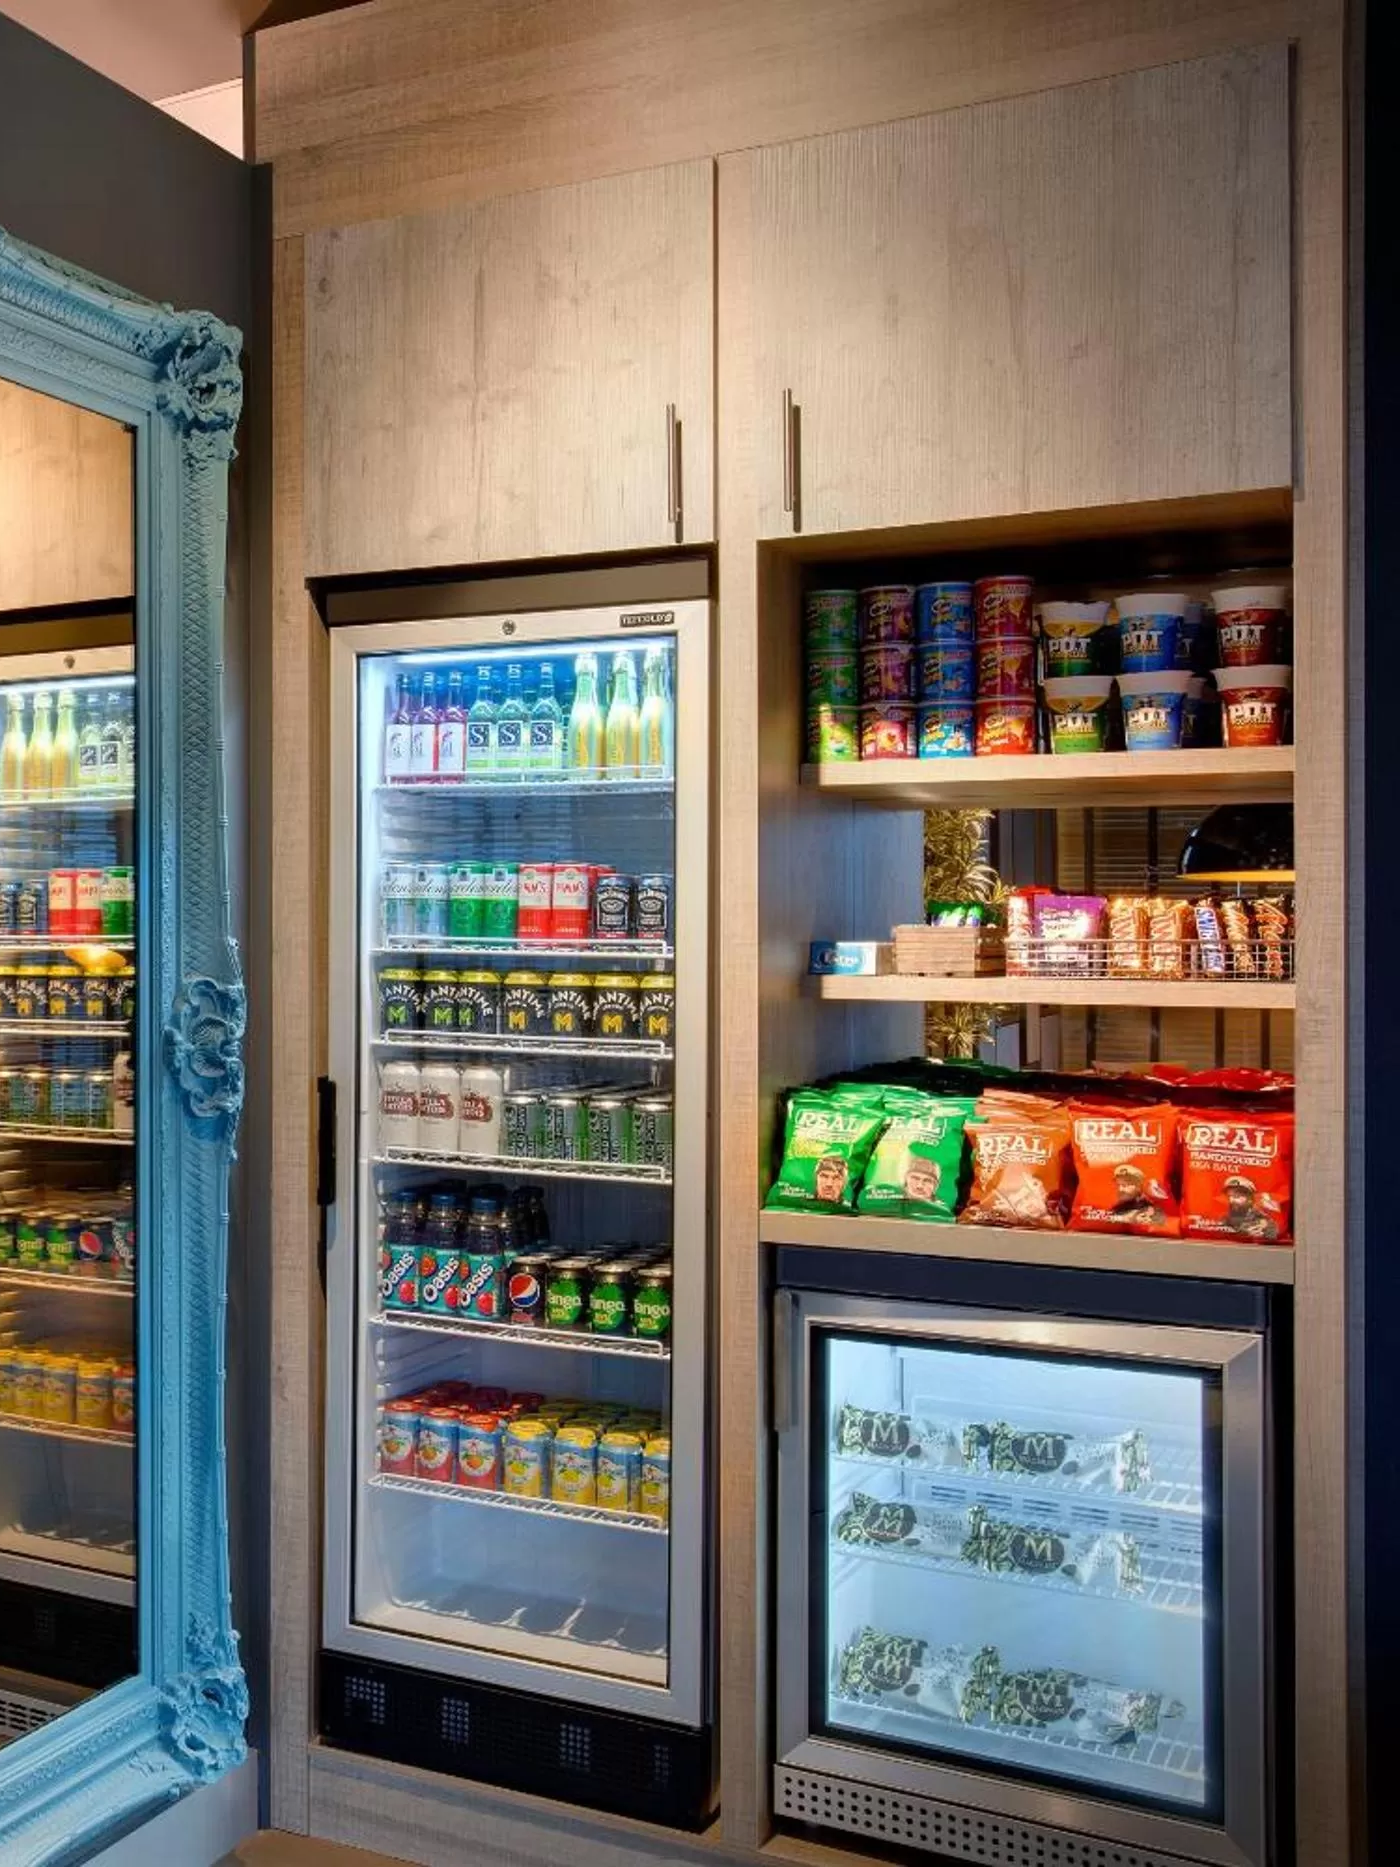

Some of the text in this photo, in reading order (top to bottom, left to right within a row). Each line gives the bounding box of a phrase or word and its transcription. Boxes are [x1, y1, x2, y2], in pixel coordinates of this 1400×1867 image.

[1048, 637, 1091, 656] POT
[1220, 624, 1266, 647] POT
[1228, 701, 1277, 723] POT
[801, 1111, 857, 1132] REAL
[1080, 1120, 1157, 1142] REAL
[978, 1135, 1047, 1155] REAL
[1191, 1126, 1272, 1153] REAL
[382, 1252, 415, 1297] Oasis
[423, 1257, 460, 1303] Oasis
[460, 1263, 493, 1308] Oasis
